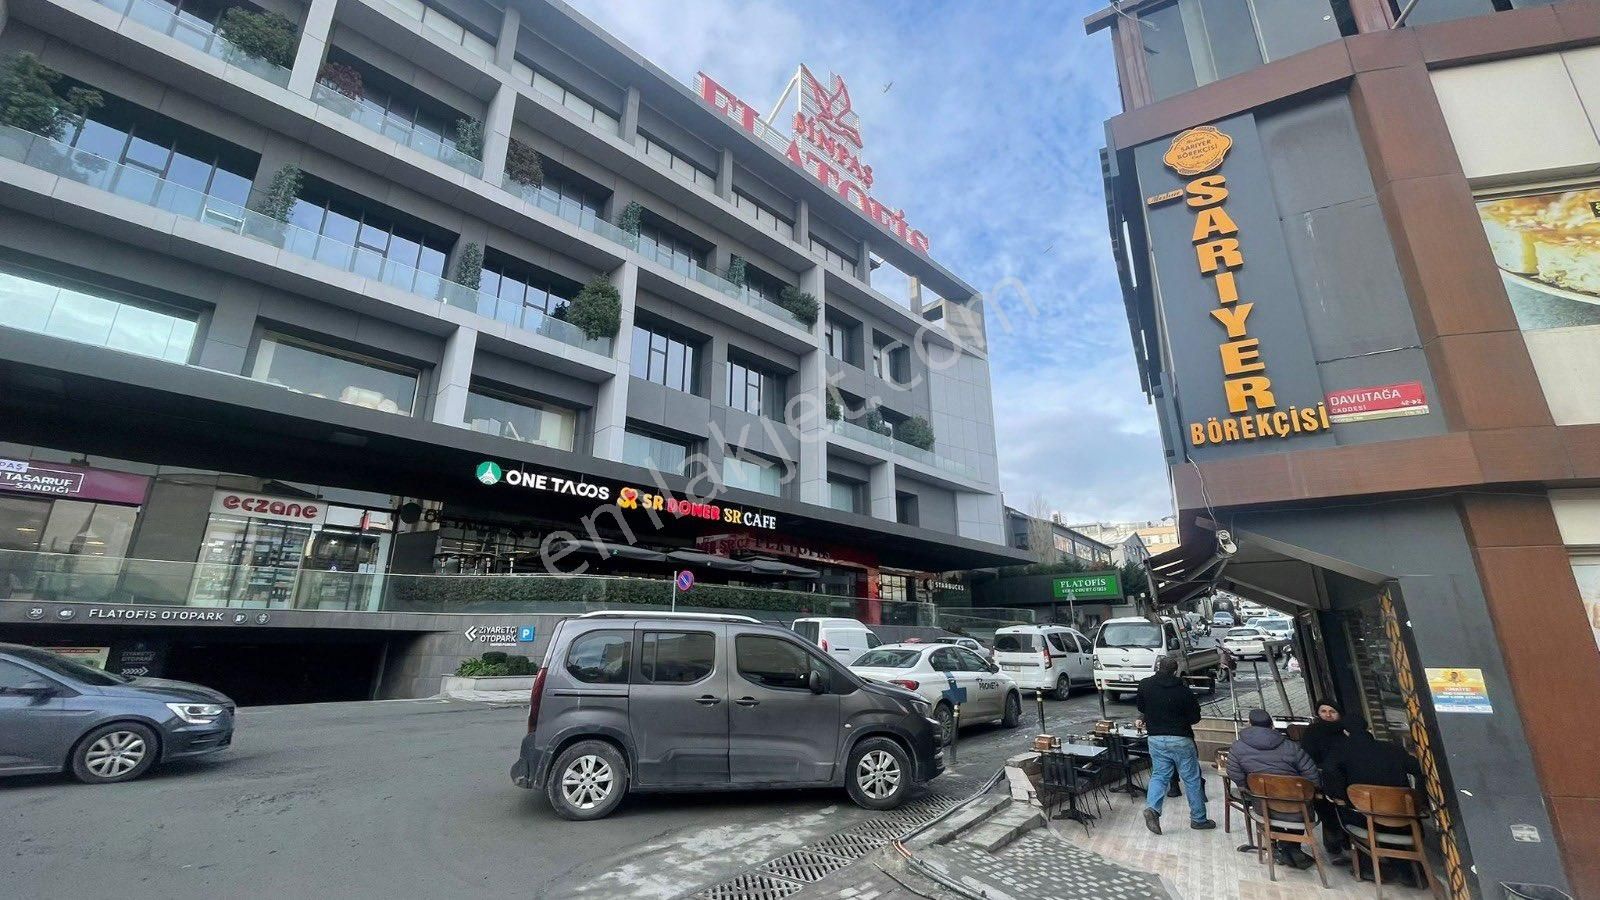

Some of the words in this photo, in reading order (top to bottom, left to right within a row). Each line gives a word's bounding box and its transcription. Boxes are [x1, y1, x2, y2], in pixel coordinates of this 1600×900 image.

[1186, 175, 1277, 413] SARIYER
[1330, 388, 1401, 406] DAVUTAĞA
[1190, 401, 1330, 445] BÖREKÇİSİ
[5, 472, 74, 486] TASARRUF
[506, 469, 548, 490] ONE
[551, 477, 610, 500] TACOS
[222, 495, 318, 519] eczane
[723, 508, 742, 524] SR
[743, 511, 777, 530] CAFE
[89, 608, 157, 619] FLATOFİS
[161, 610, 225, 621] OTOPARK
[479, 625, 517, 635] ZİYARETÇİ
[480, 634, 517, 643] OTOPARK
